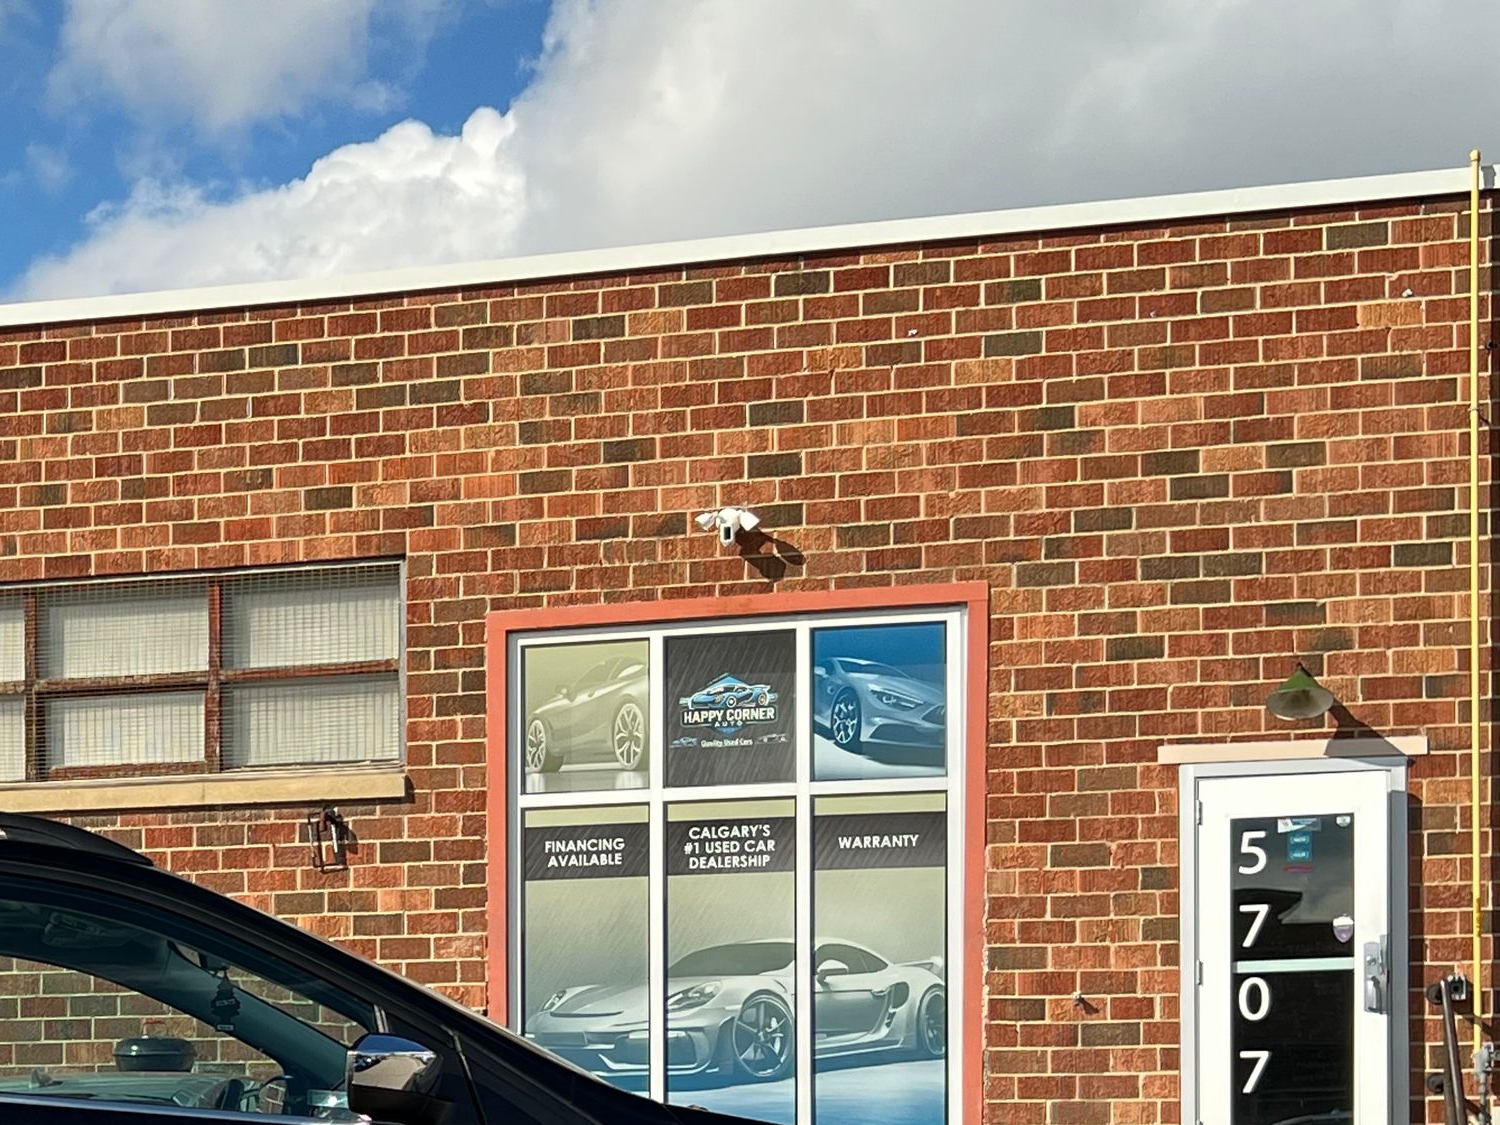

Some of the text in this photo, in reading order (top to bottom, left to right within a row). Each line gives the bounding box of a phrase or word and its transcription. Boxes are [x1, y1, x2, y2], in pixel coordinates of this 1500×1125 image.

[683, 707, 775, 724] HAPPY CORNER
[688, 824, 771, 839] CALGARY'S
[545, 838, 625, 853] FINANCING
[684, 840, 775, 855] #1 USED CAR
[838, 834, 919, 849] WARRANTY
[547, 852, 622, 868] AVAILABLE
[688, 854, 771, 869] DEALERSHIP
[1238, 830, 1270, 1093] 5707
